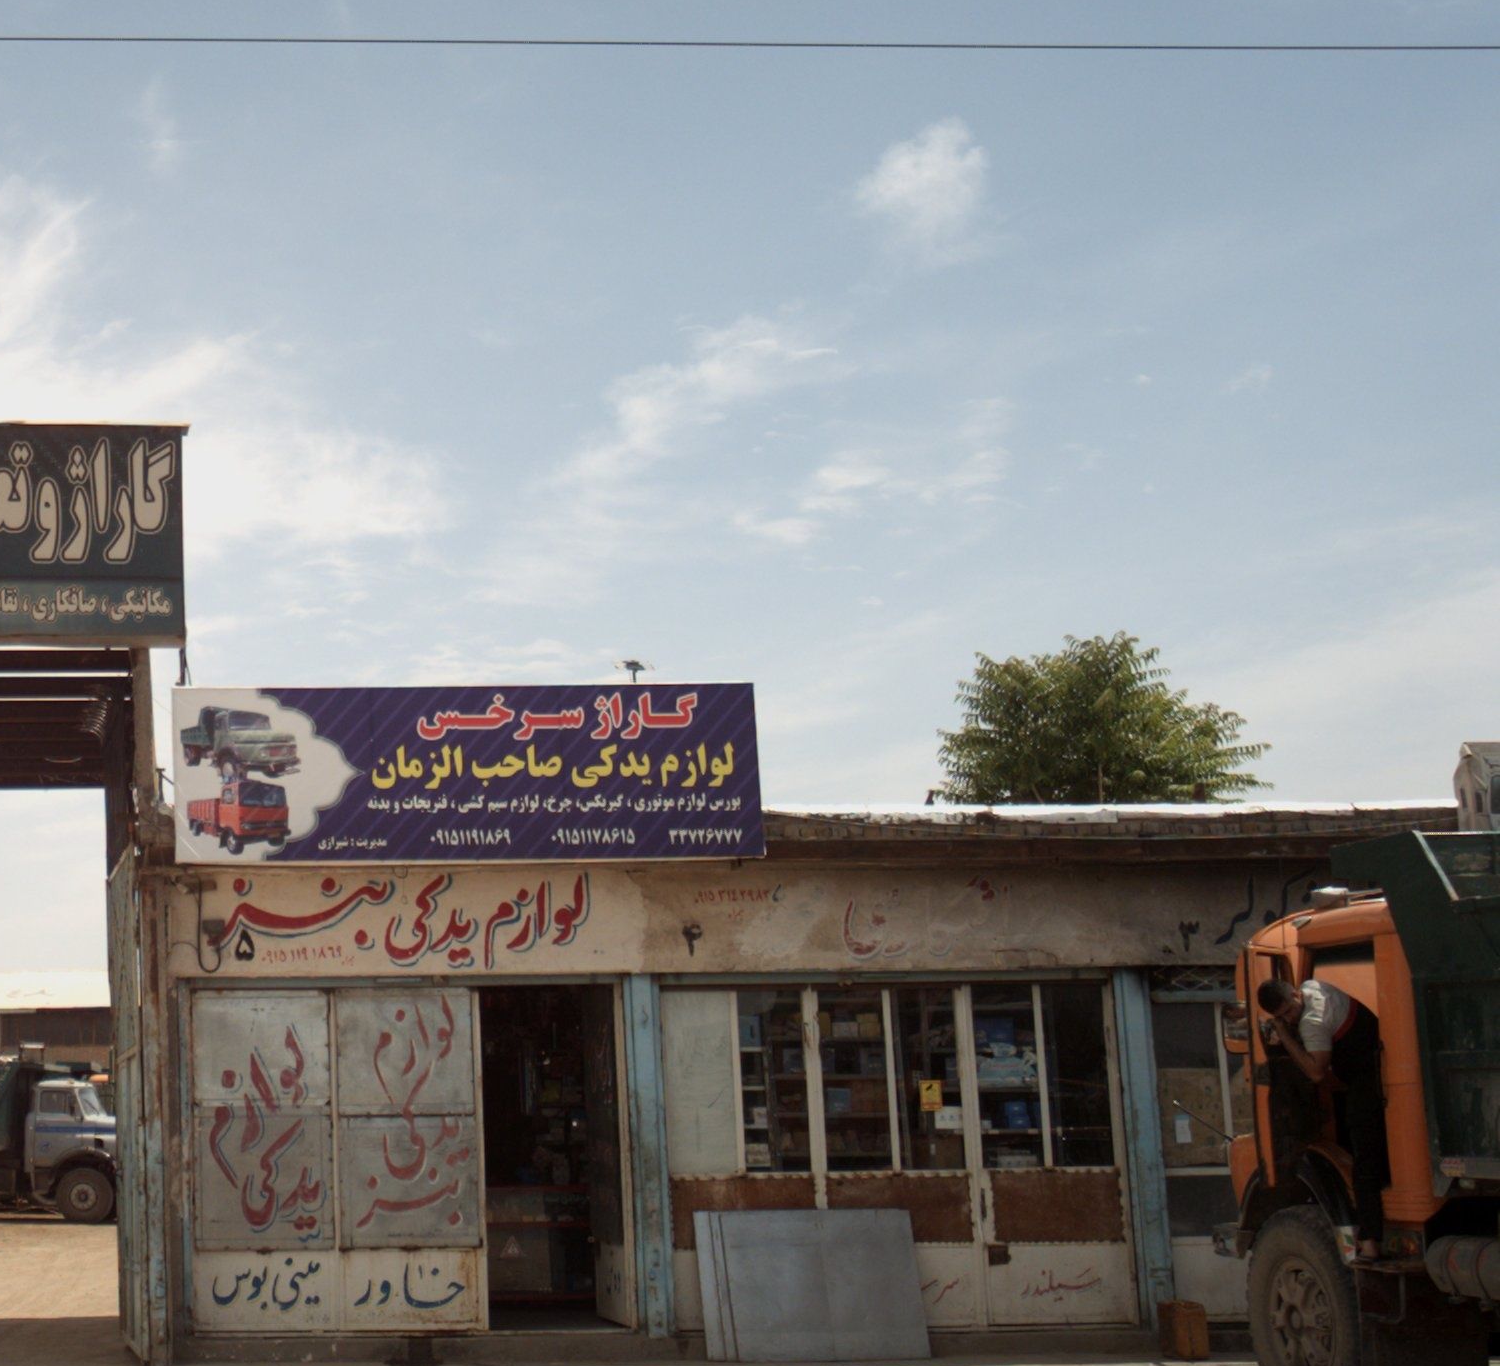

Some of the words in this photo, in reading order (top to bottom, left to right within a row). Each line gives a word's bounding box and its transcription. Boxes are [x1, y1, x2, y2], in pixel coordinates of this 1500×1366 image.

[29, 476, 61, 564] و
[59, 437, 176, 564] گاراژ
[416, 692, 585, 741] سرخس
[590, 691, 698, 740] گاراژ
[372, 744, 464, 790] الزمان
[471, 743, 563, 788] صاحب
[571, 742, 651, 788] یدکی
[660, 742, 734, 788] لوازم
[367, 795, 391, 812] بدنه
[487, 797, 507, 813] سیم
[510, 793, 540, 813] لوازم
[677, 792, 706, 812] لوازم
[708, 796, 741, 812] بورس
[318, 836, 349, 851] شیرازی
[206, 875, 397, 952] بنز
[384, 872, 479, 970] یدکی
[482, 872, 590, 971] لوازم
[234, 928, 255, 961] ۵
[372, 993, 455, 1106] لوازم
[208, 1023, 309, 1191] لوازم
[383, 1058, 470, 1182] یدکی
[240, 1118, 328, 1243] یدکی
[355, 1166, 464, 1229] بنز
[212, 1265, 268, 1311] بوس
[272, 1257, 322, 1311] مینی
[354, 1263, 466, 1309] خاور
